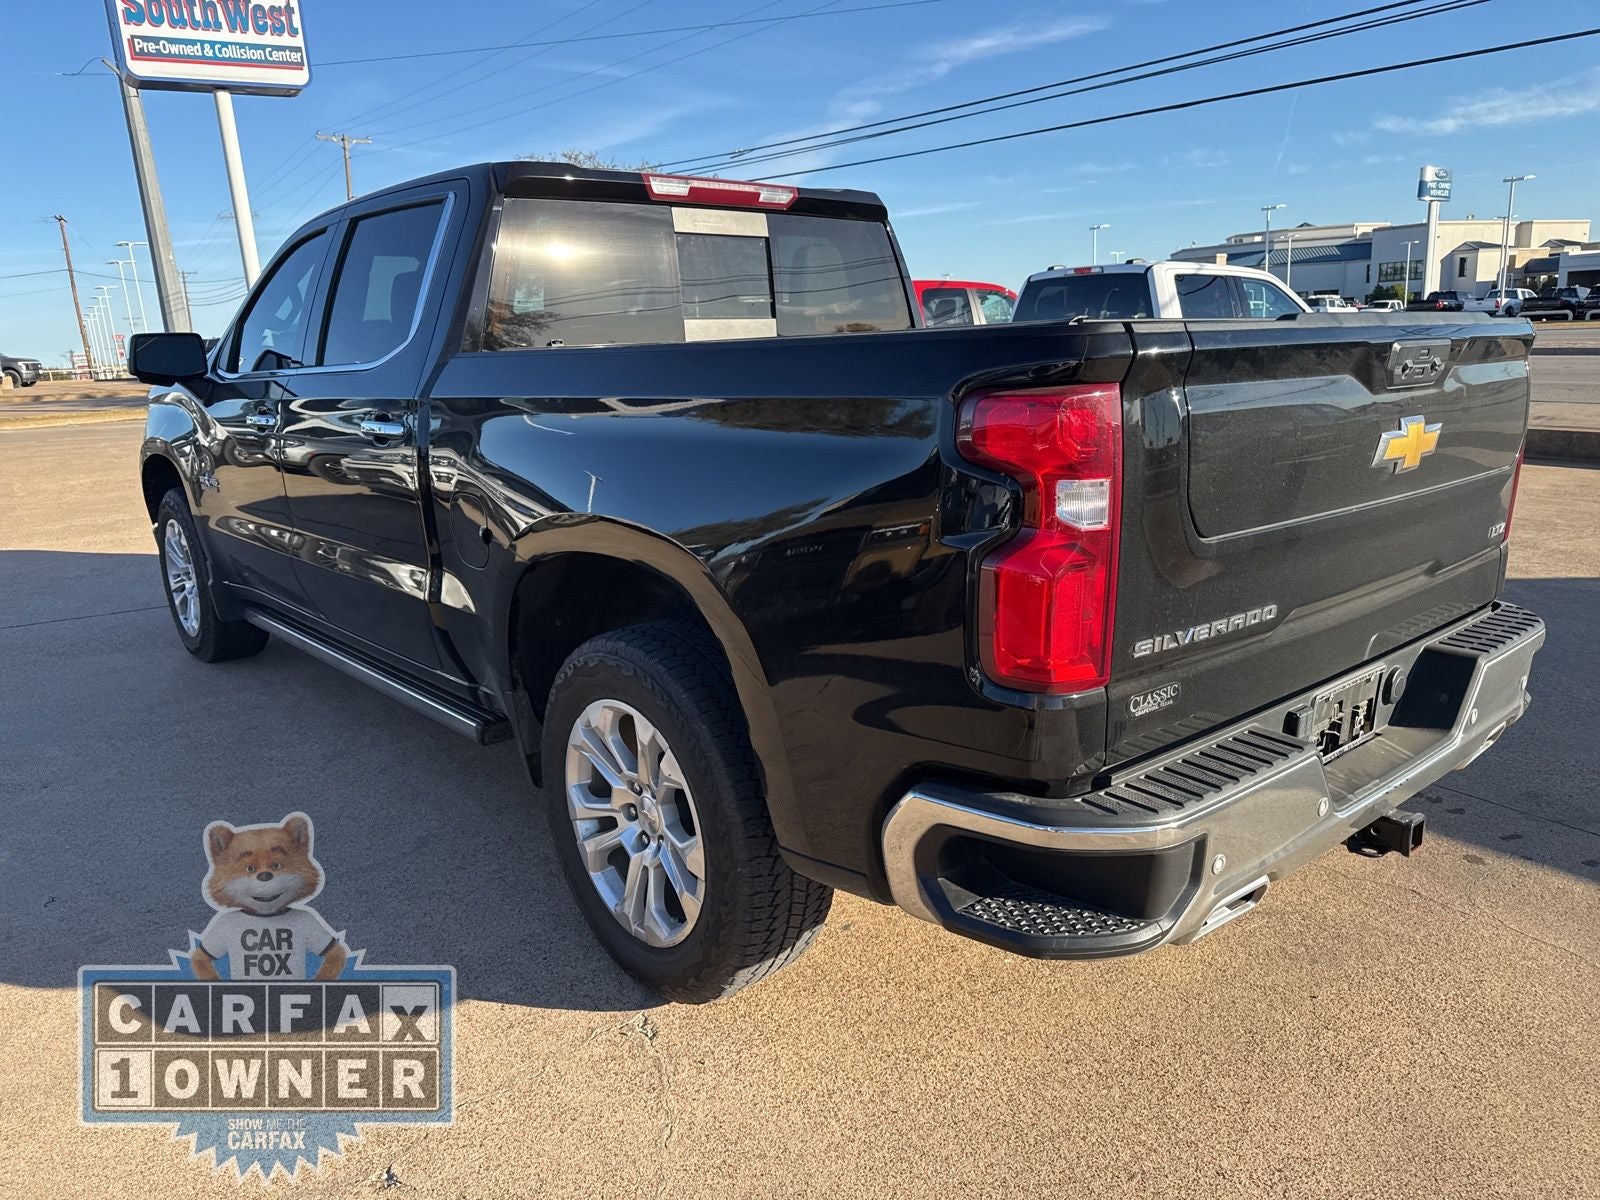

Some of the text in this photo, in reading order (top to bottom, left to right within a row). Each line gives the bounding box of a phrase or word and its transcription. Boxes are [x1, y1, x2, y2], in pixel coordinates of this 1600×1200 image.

[134, 38, 302, 63] Pre-Owned & Collision Center
[1132, 604, 1278, 658] SILVERADO
[1130, 684, 1178, 713] CLASSIC
